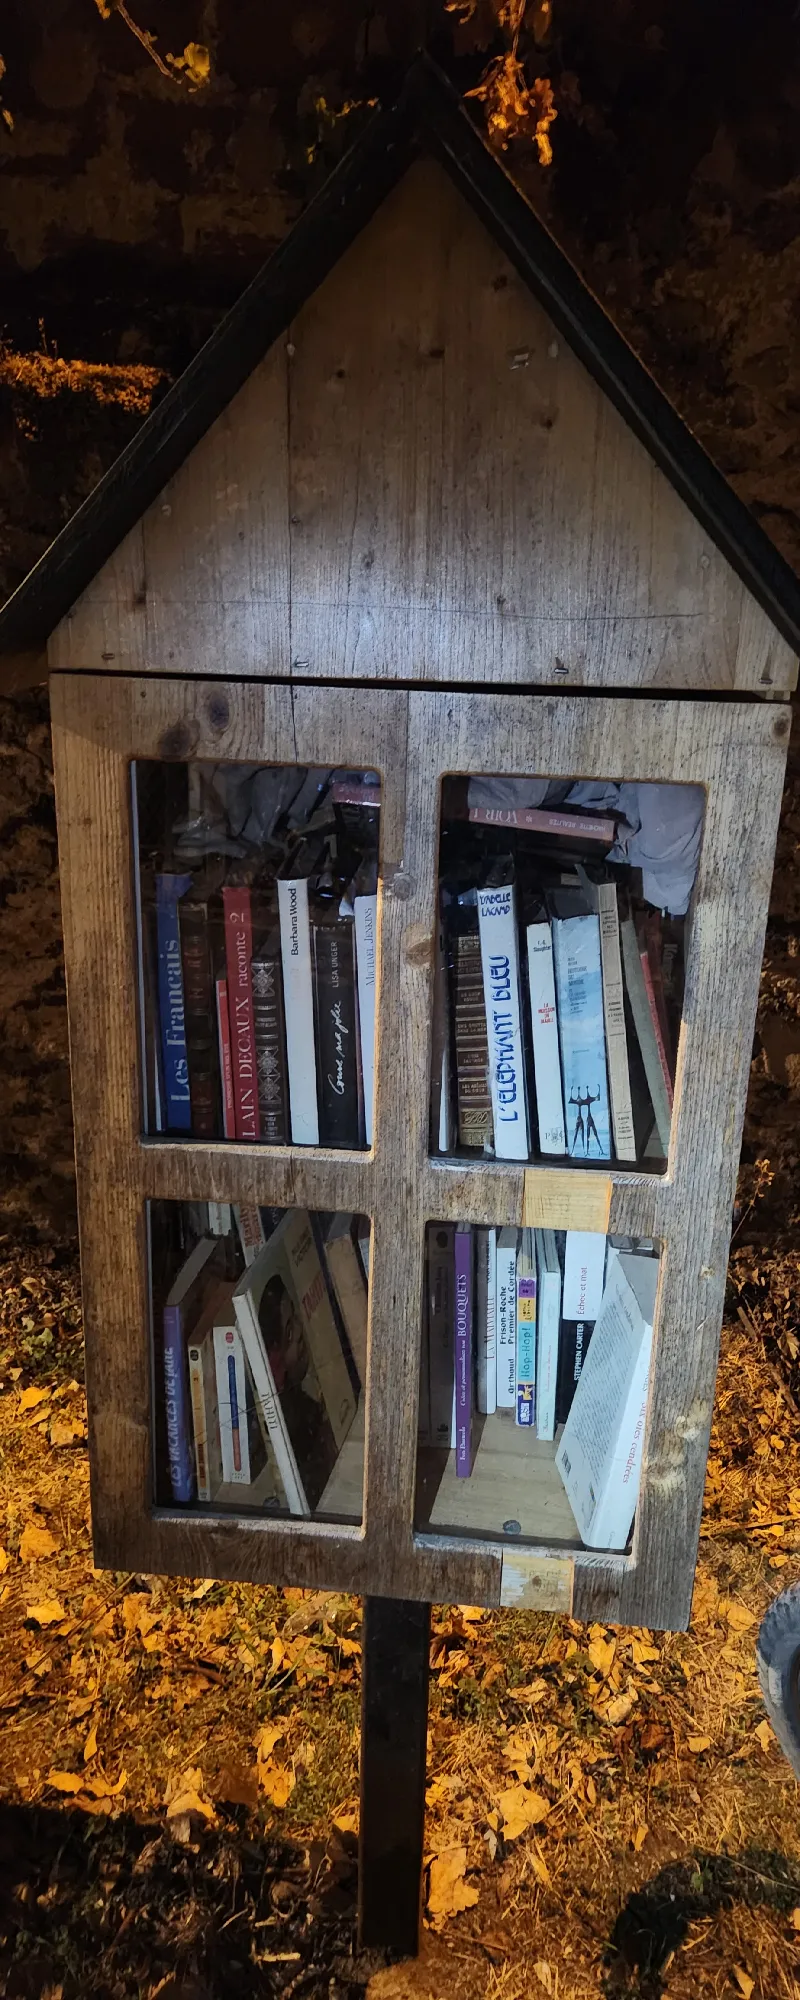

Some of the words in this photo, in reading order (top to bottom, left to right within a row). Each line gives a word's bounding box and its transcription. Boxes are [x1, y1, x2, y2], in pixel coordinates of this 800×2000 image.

[288, 888, 298, 915] Wood
[290, 915, 299, 956] Barbara
[238, 931, 249, 987] raconte
[489, 955, 512, 1001] BLEU
[236, 997, 253, 1079] DECAUX
[171, 1059, 191, 1102] Les
[240, 1088, 256, 1140] LAIN
[507, 1261, 515, 1293] Cordée
[579, 1283, 586, 1291] et
[580, 1267, 588, 1281] mat
[457, 1274, 468, 1337] BOUQUETS
[507, 1295, 515, 1306] de
[576, 1293, 586, 1315] Échec
[507, 1311, 515, 1345] Premier
[575, 1323, 584, 1350] CARTER
[522, 1327, 532, 1377] Hop-Hop!
[573, 1351, 583, 1381] STEPHEN
[166, 1399, 181, 1461] VACANCES
[634, 1420, 643, 1440] oies
[623, 1442, 637, 1484] cendrées
